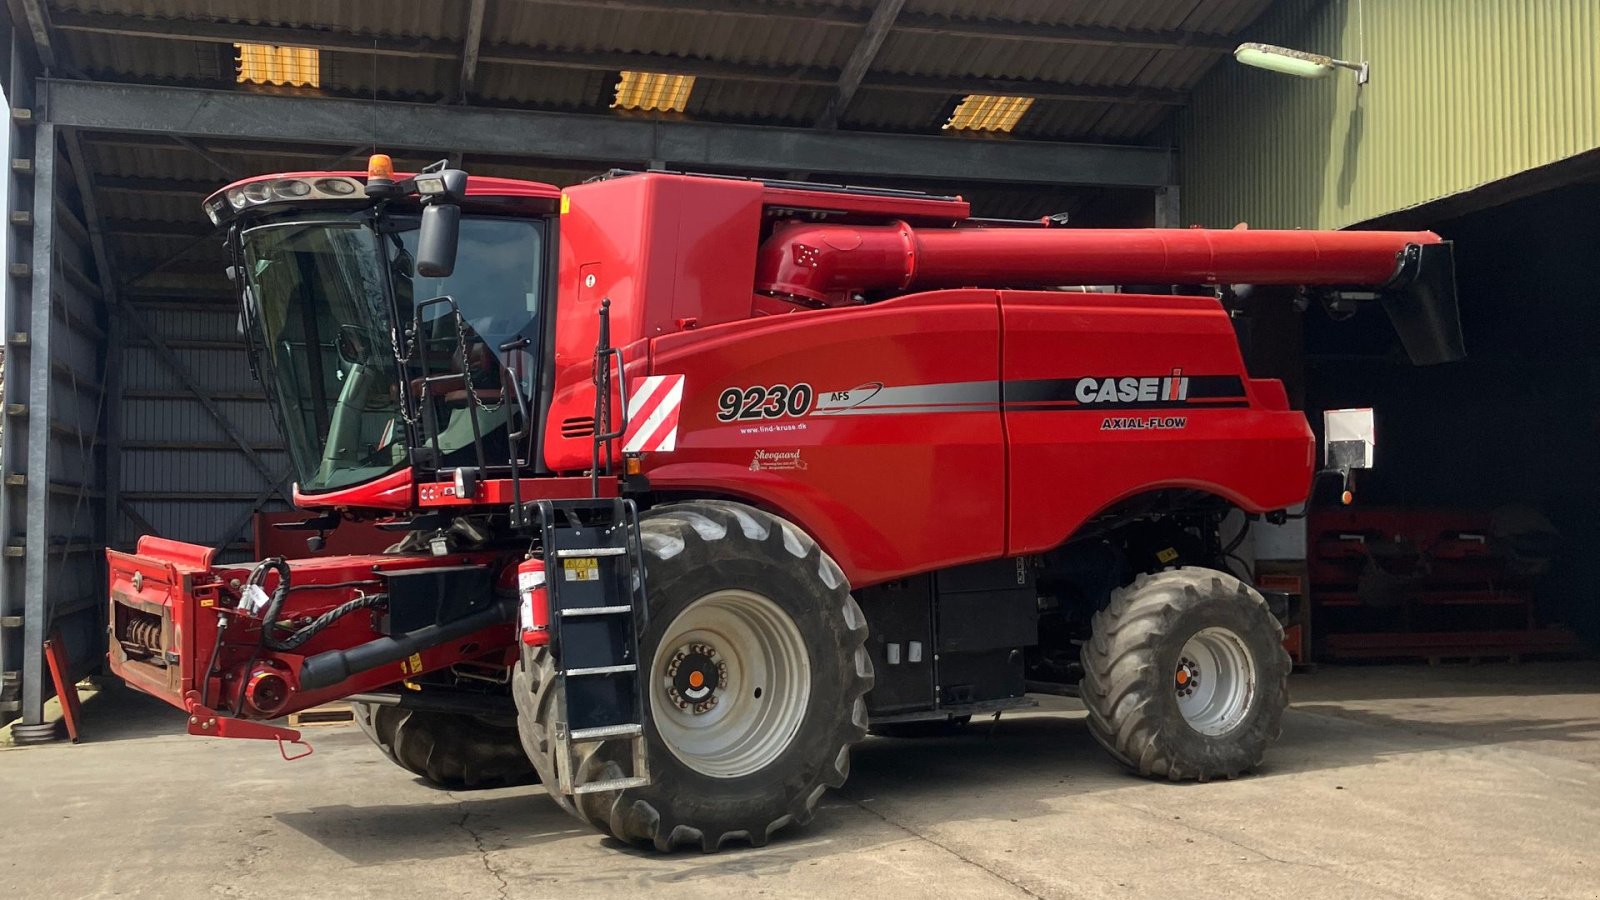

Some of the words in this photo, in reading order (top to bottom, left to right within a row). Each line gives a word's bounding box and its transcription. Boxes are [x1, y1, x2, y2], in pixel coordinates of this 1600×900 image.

[830, 391, 850, 402] AFS
[1075, 377, 1159, 403] CASE
[717, 383, 812, 422] 9230
[740, 423, 807, 434] www.lind-kruse.dk
[1101, 416, 1187, 430] AXIAL-FLOW
